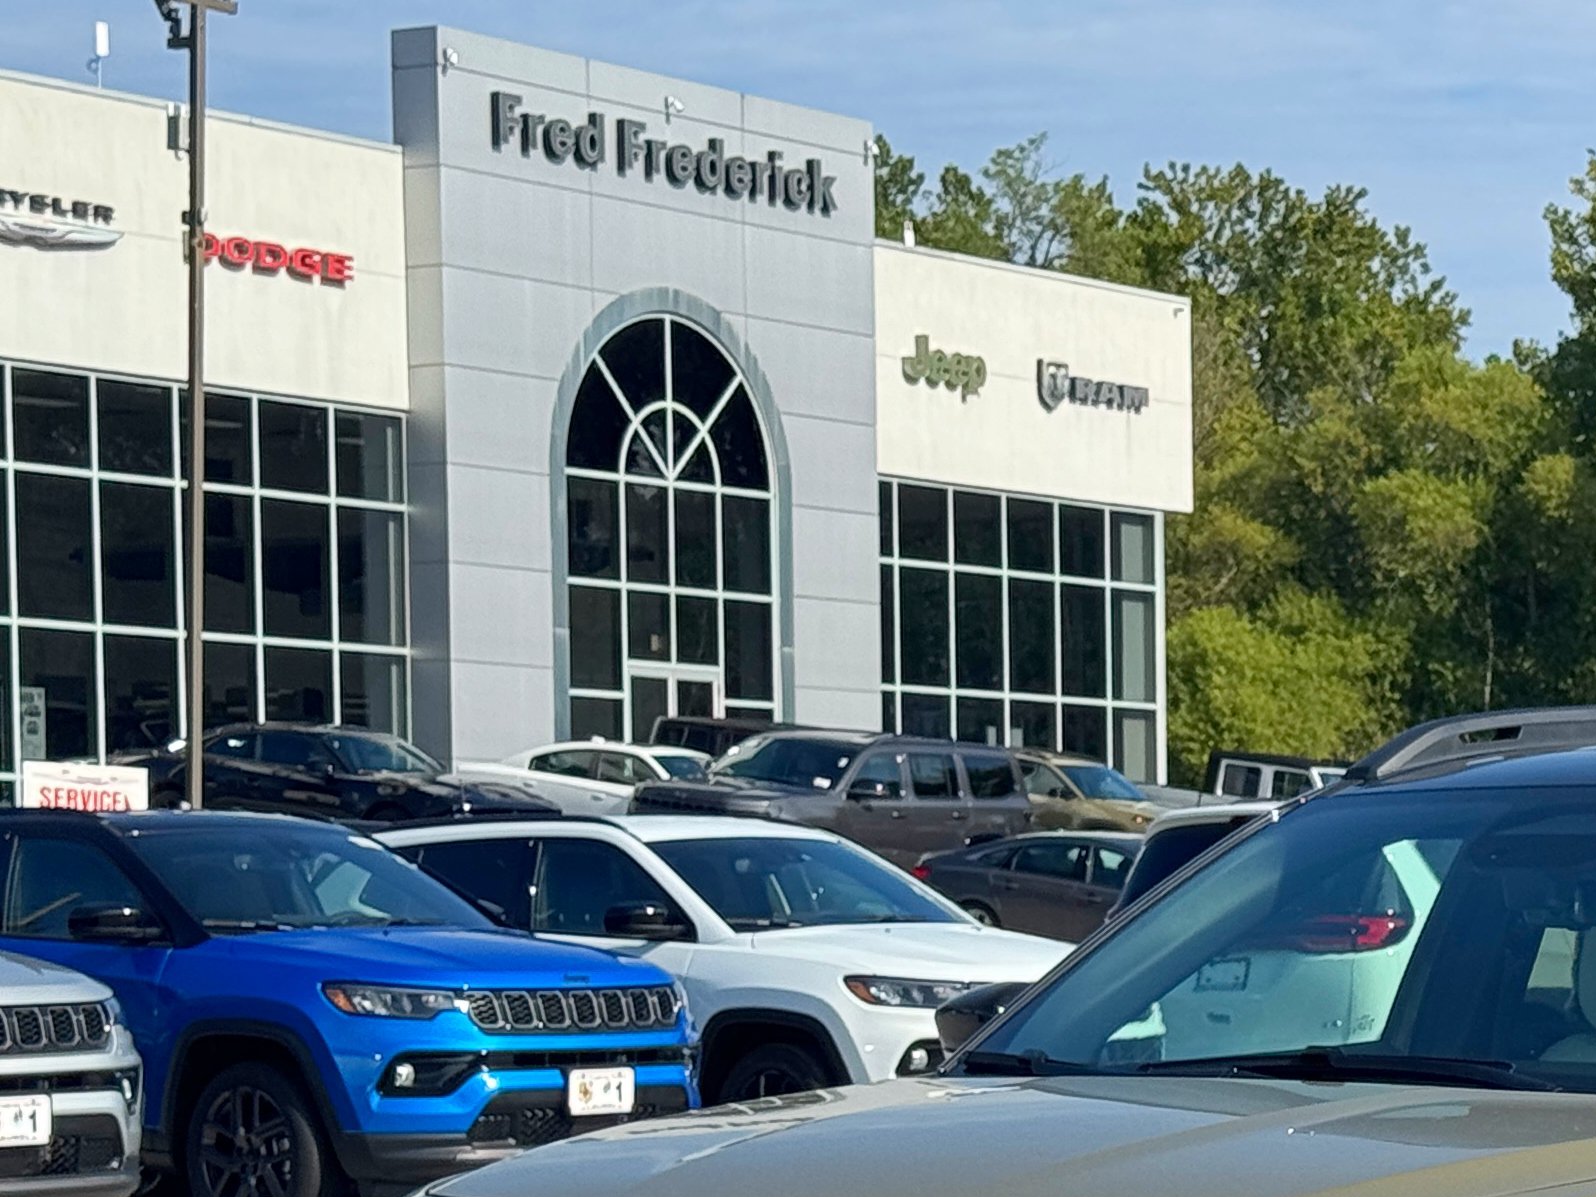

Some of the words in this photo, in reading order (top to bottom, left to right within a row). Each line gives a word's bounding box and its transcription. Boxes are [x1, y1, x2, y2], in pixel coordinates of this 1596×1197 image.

[490, 91, 604, 172] Fred
[617, 118, 837, 217] Frederick
[0, 189, 115, 225] YSLER
[902, 335, 987, 404] Jeep
[1069, 377, 1149, 414] RAM
[40, 786, 122, 811] SERVICE
